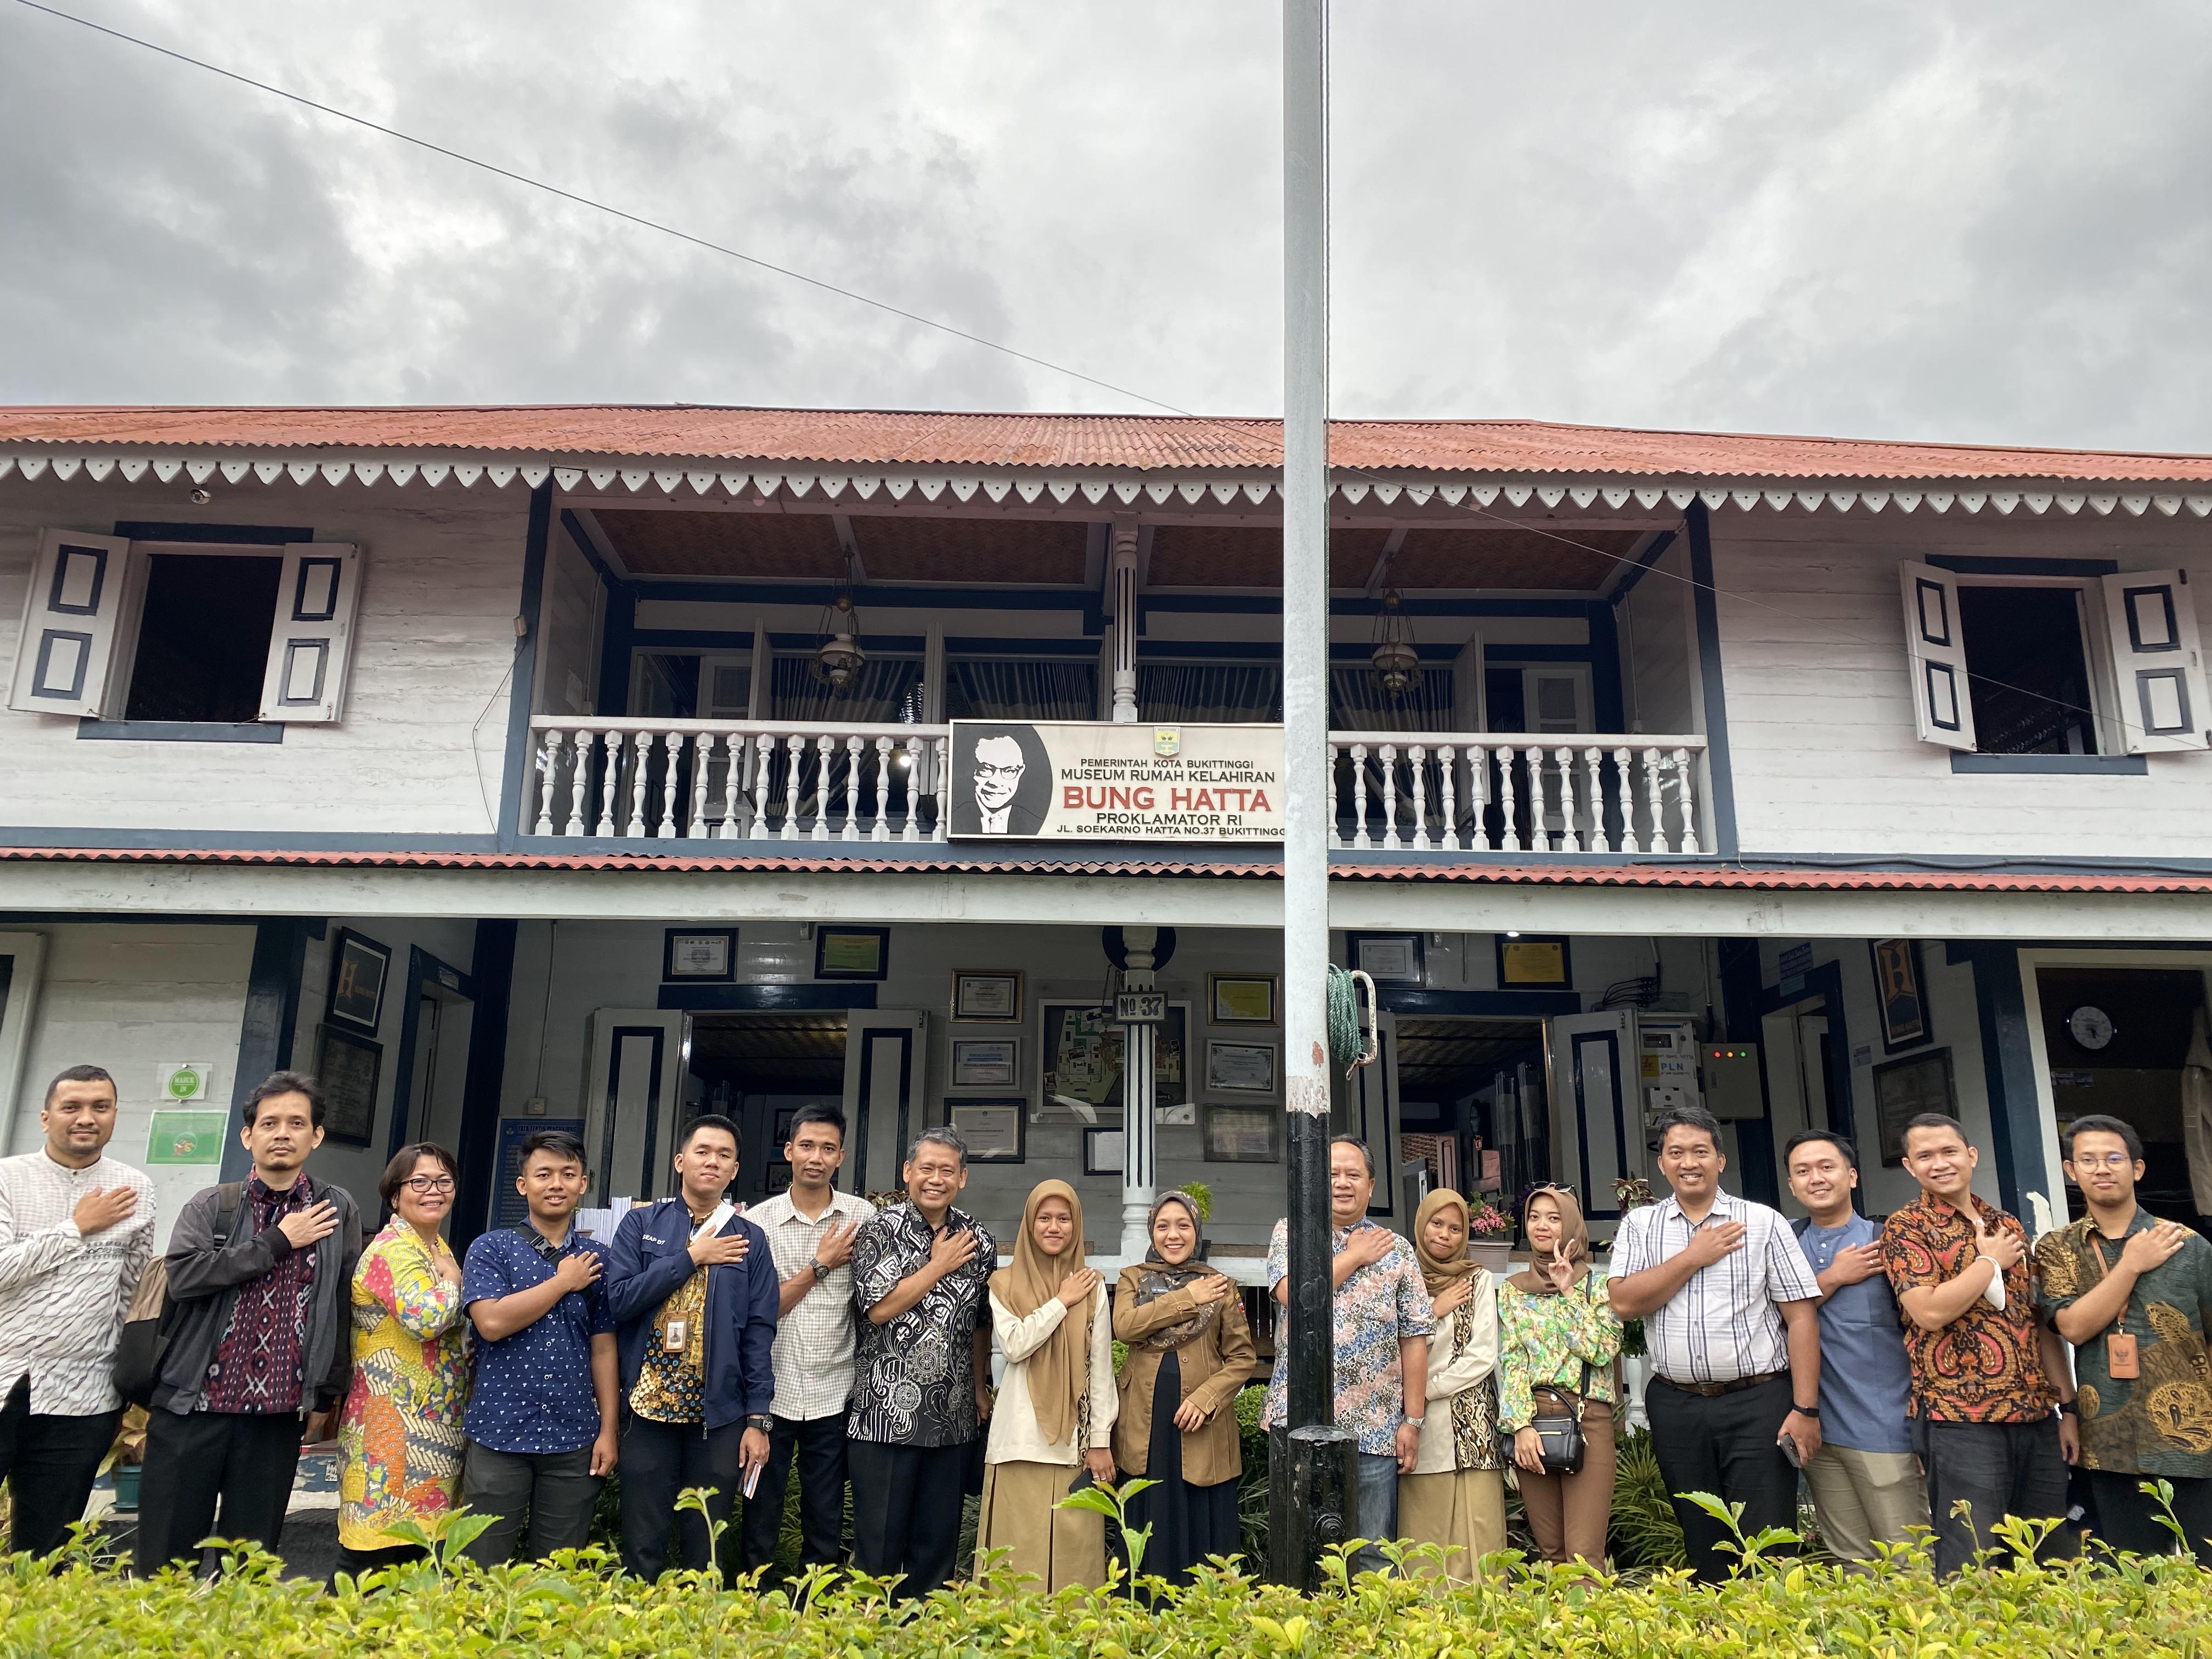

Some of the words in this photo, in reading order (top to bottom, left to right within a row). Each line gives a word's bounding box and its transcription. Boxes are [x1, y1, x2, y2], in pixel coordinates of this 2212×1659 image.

[1081, 759, 1148, 768] PEMERINTAH
[1154, 760, 1182, 768] KOTA
[1187, 760, 1254, 769] BUKITTINGGI
[1062, 769, 1125, 781] MUSEUM
[1131, 770, 1184, 782] RUMAH
[1188, 771, 1275, 783] KELAHIRAN
[1063, 786, 1155, 810] BUNG
[1171, 788, 1272, 812] HATTA
[1097, 813, 1221, 826] PROKLAMATOR
[1227, 815, 1243, 826] RI
[1057, 825, 1073, 833] JL.
[1076, 825, 1141, 834] SOEKARNO
[1146, 826, 1181, 834] HATTA
[1184, 826, 1215, 835] NO.37
[1219, 827, 1285, 836] BUKITTINGG
[1141, 997, 1162, 1016] 37
[1661, 1063, 1683, 1071] PLN
